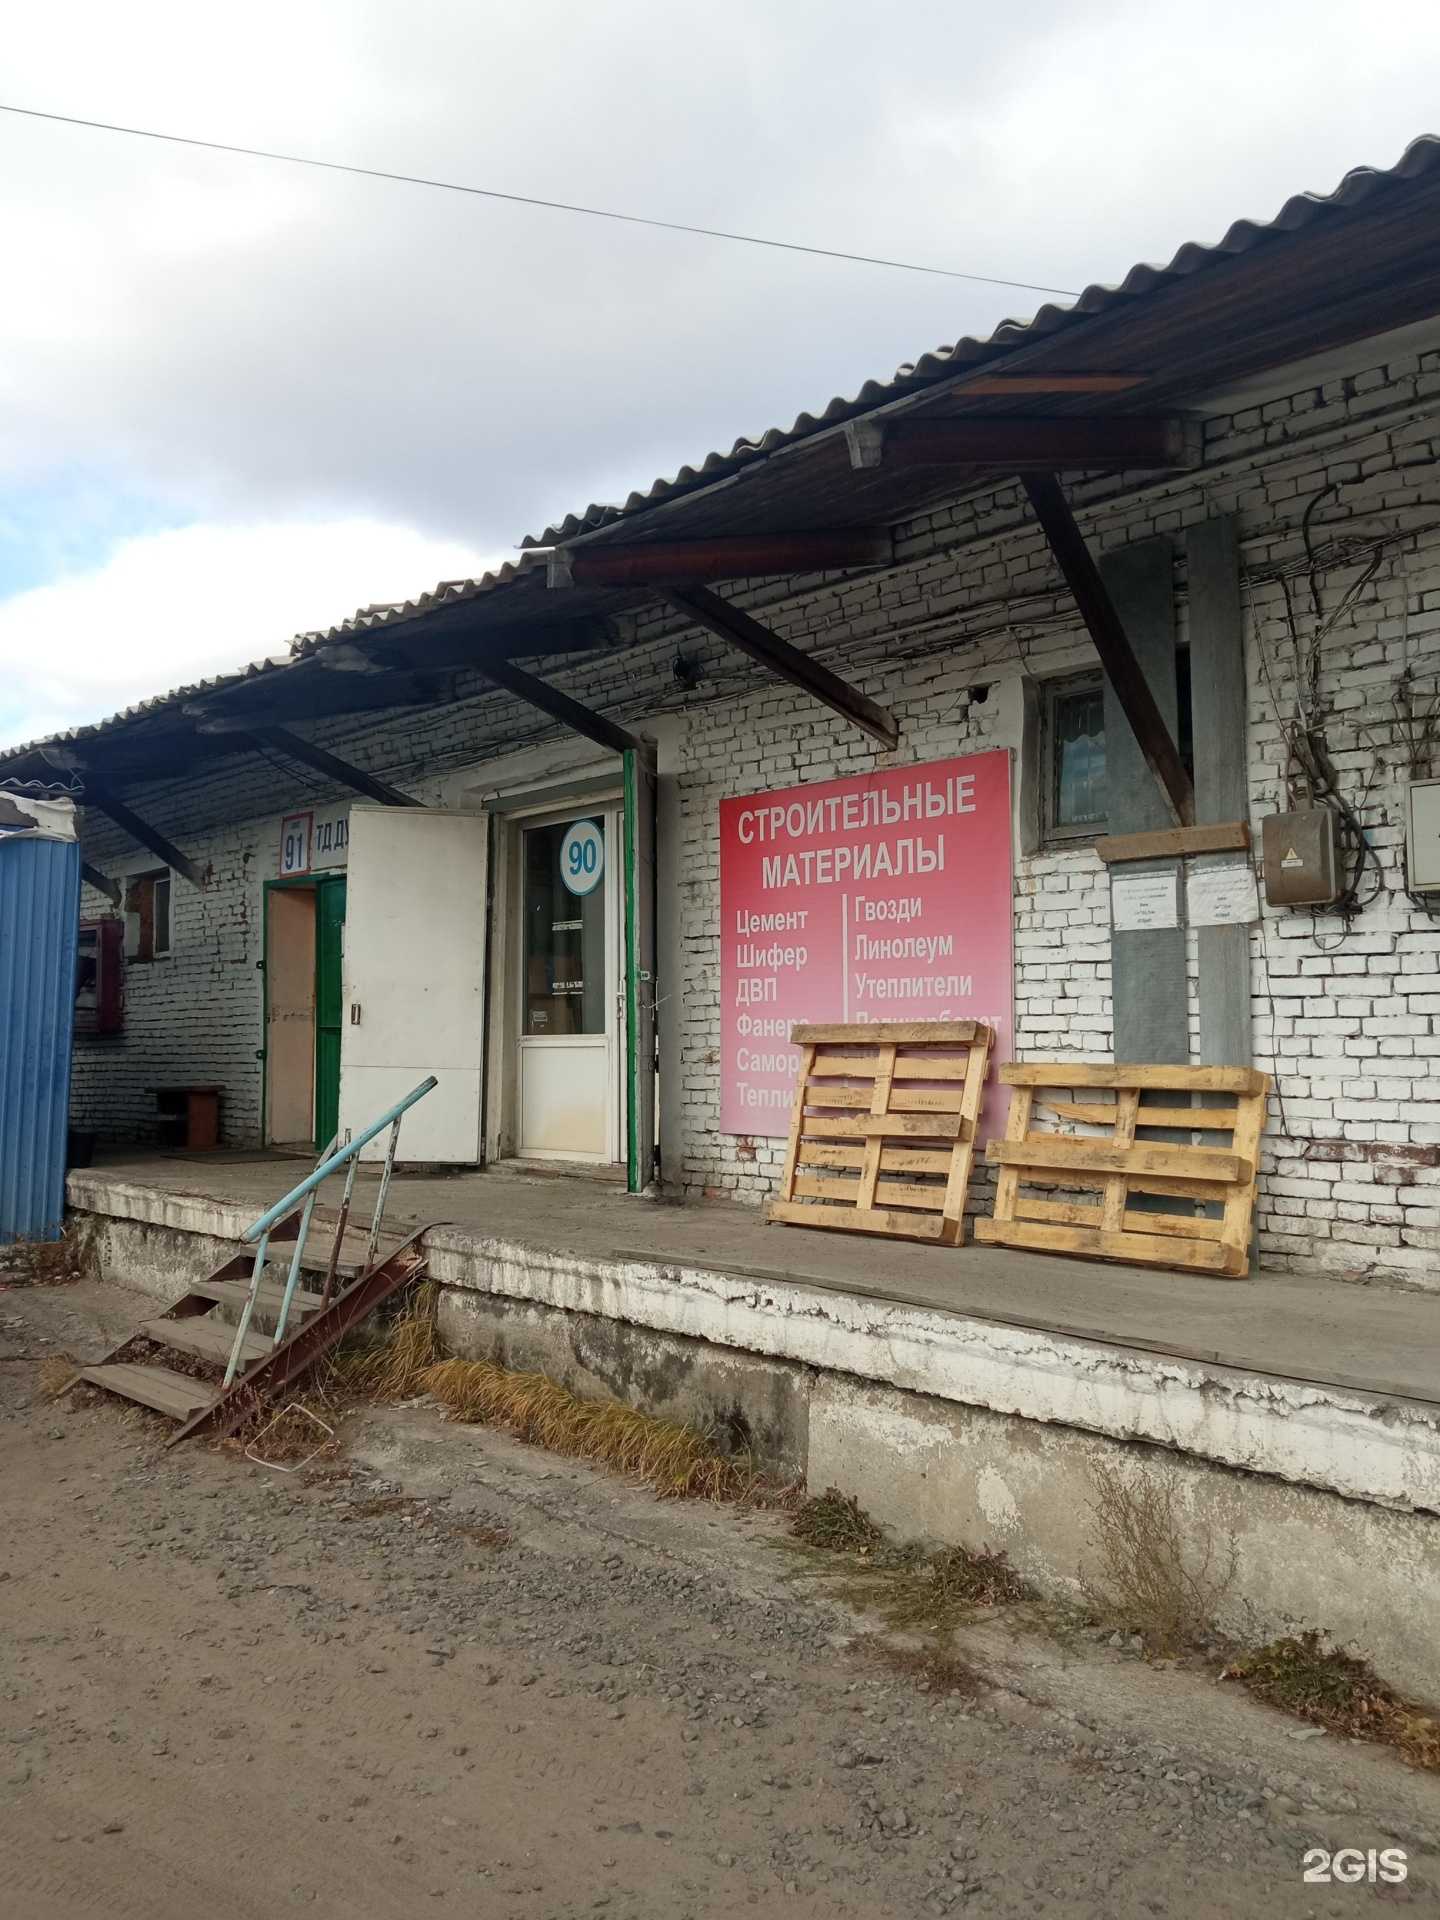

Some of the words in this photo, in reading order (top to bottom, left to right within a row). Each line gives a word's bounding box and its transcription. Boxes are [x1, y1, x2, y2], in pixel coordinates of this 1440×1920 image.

[738, 774, 977, 845] СТРОИТЕЛЬНЫЕ
[285, 833, 303, 870] 91
[568, 838, 597, 876] 90
[762, 834, 945, 889] МАТЕРИАЛЫ
[736, 909, 809, 938] Цемент
[854, 895, 922, 923] Гвозди
[736, 943, 808, 971] Шифер
[854, 933, 953, 964] Линолеум
[736, 977, 777, 1007] ДВП
[854, 972, 973, 1000] Утеплители
[736, 1047, 803, 1079] Самор
[736, 1081, 794, 1109] Тепли
